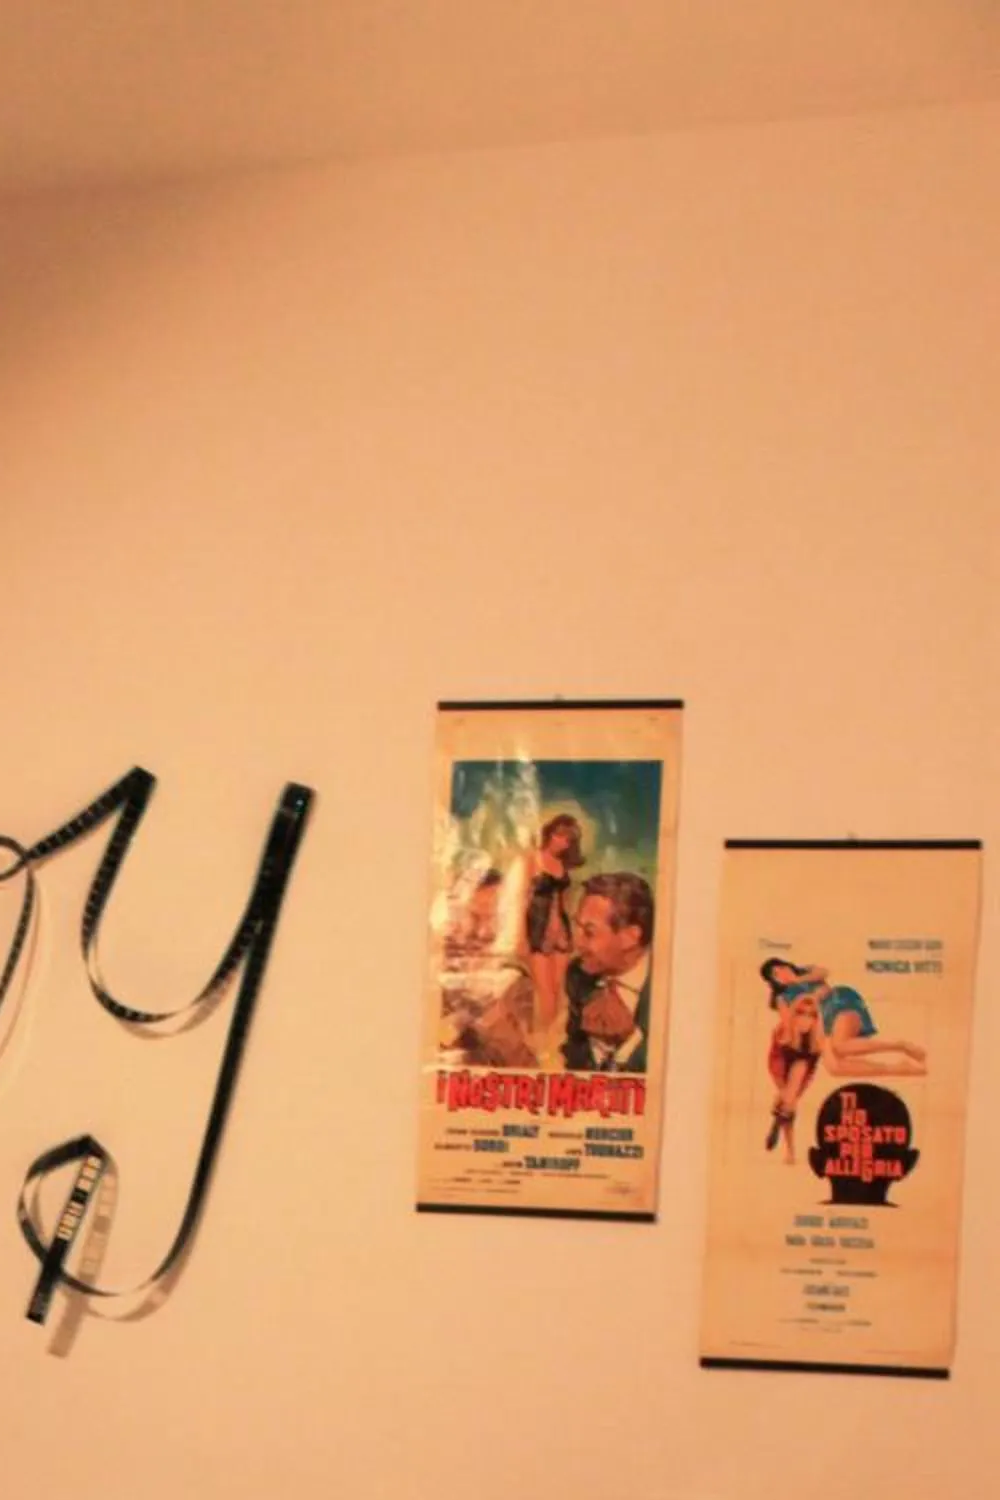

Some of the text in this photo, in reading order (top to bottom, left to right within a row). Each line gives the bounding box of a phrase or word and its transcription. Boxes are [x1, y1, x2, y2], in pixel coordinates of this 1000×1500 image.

[840, 1091, 857, 1111] TI
[823, 1125, 906, 1144] SPOSATO
[825, 1158, 904, 1183] ALLEGRIA
